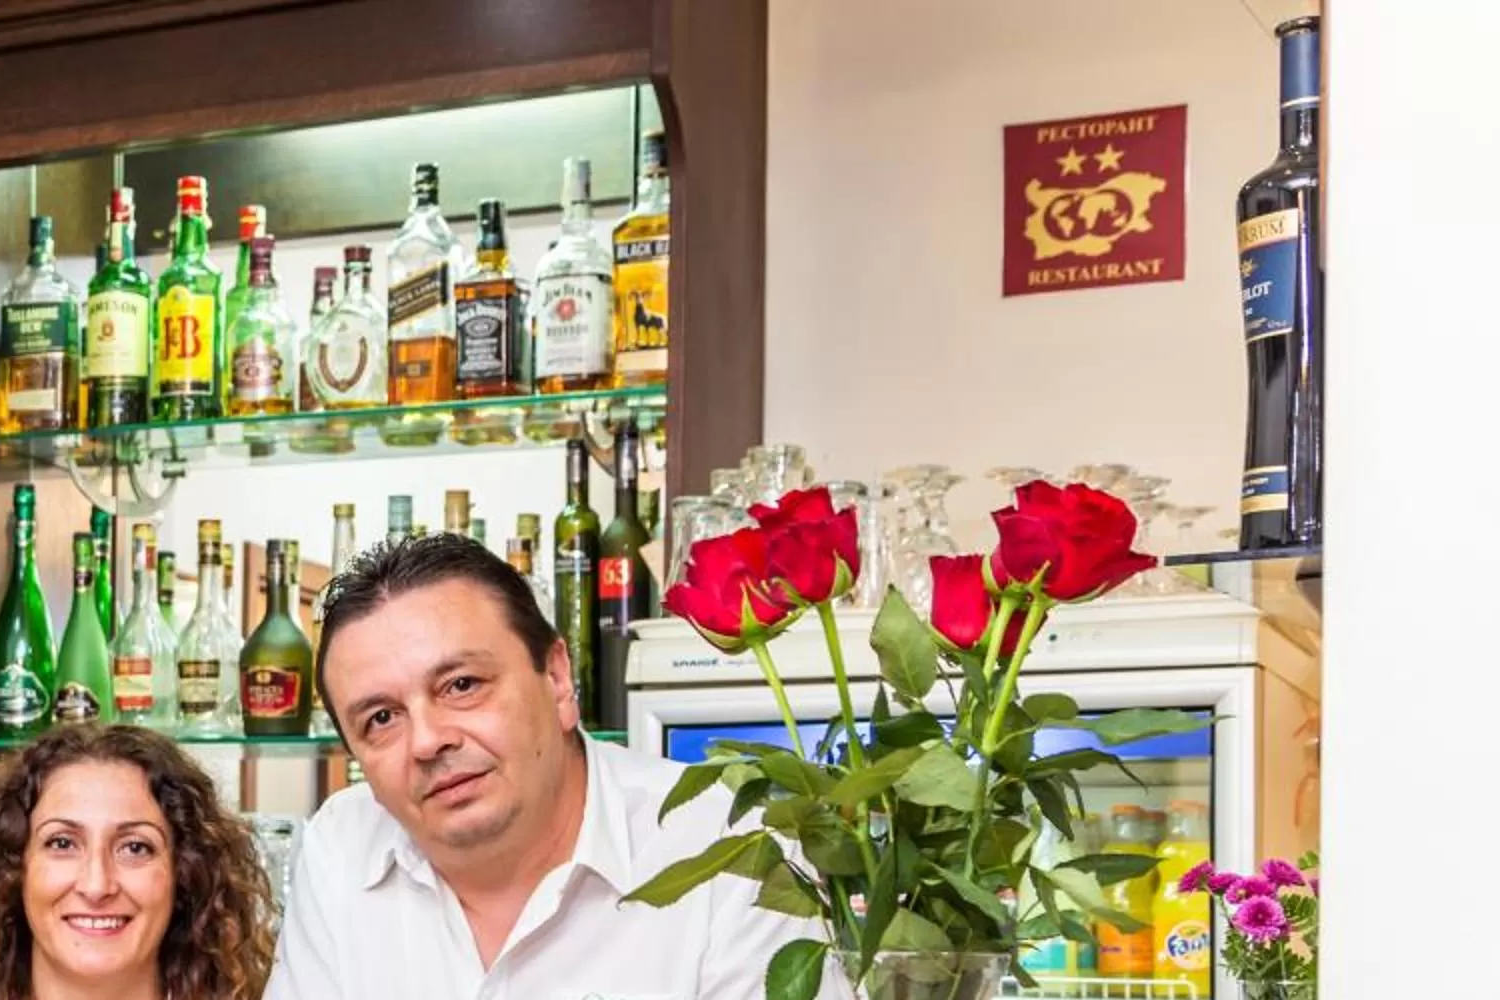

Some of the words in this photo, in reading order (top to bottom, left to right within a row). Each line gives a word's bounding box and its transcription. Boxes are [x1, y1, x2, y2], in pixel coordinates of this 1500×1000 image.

[1036, 114, 1160, 145] РЕСТОРАНТ
[1027, 258, 1165, 287] RESTAURANT
[1167, 931, 1211, 957] Fant
